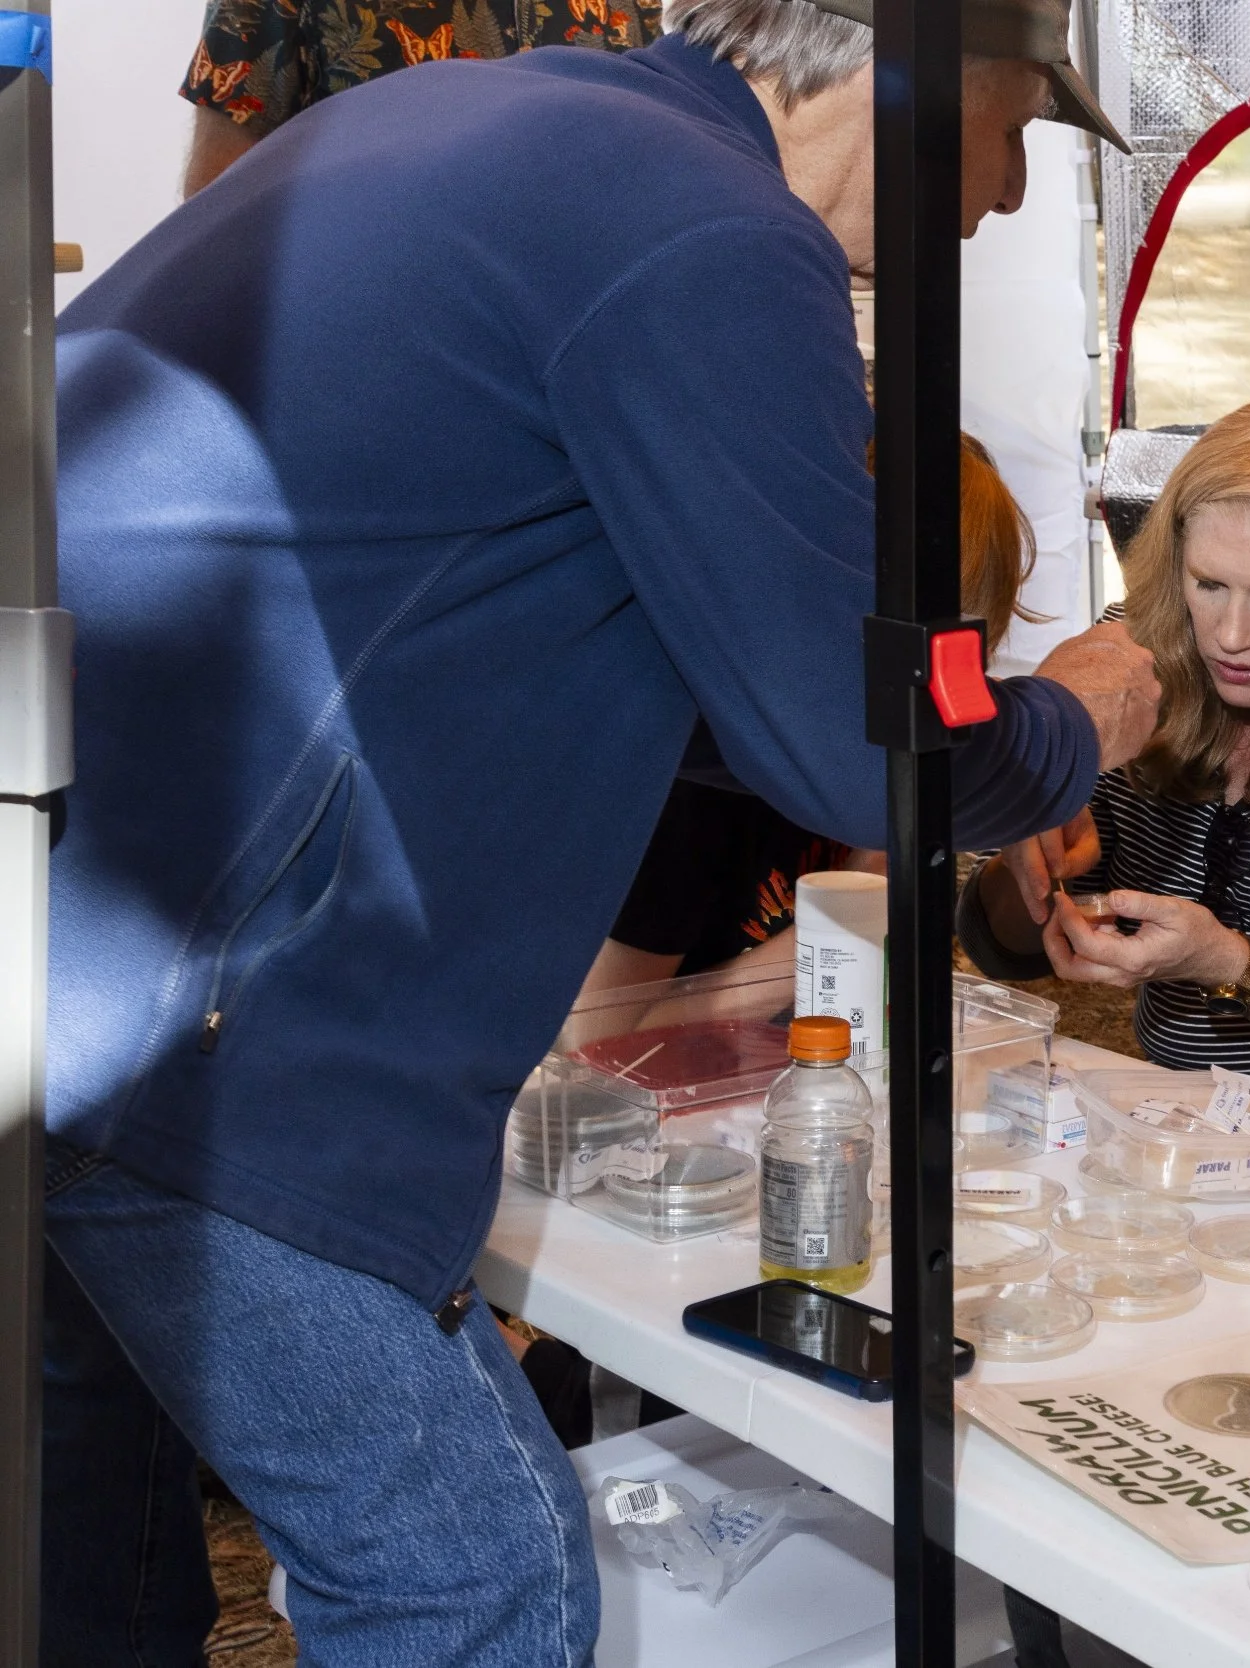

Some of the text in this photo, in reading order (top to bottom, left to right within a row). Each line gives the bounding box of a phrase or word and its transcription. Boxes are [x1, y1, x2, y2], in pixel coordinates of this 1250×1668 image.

[1014, 1426, 1168, 1506] DRAW
[1068, 1392, 1236, 1478] BLUE CHEESE!
